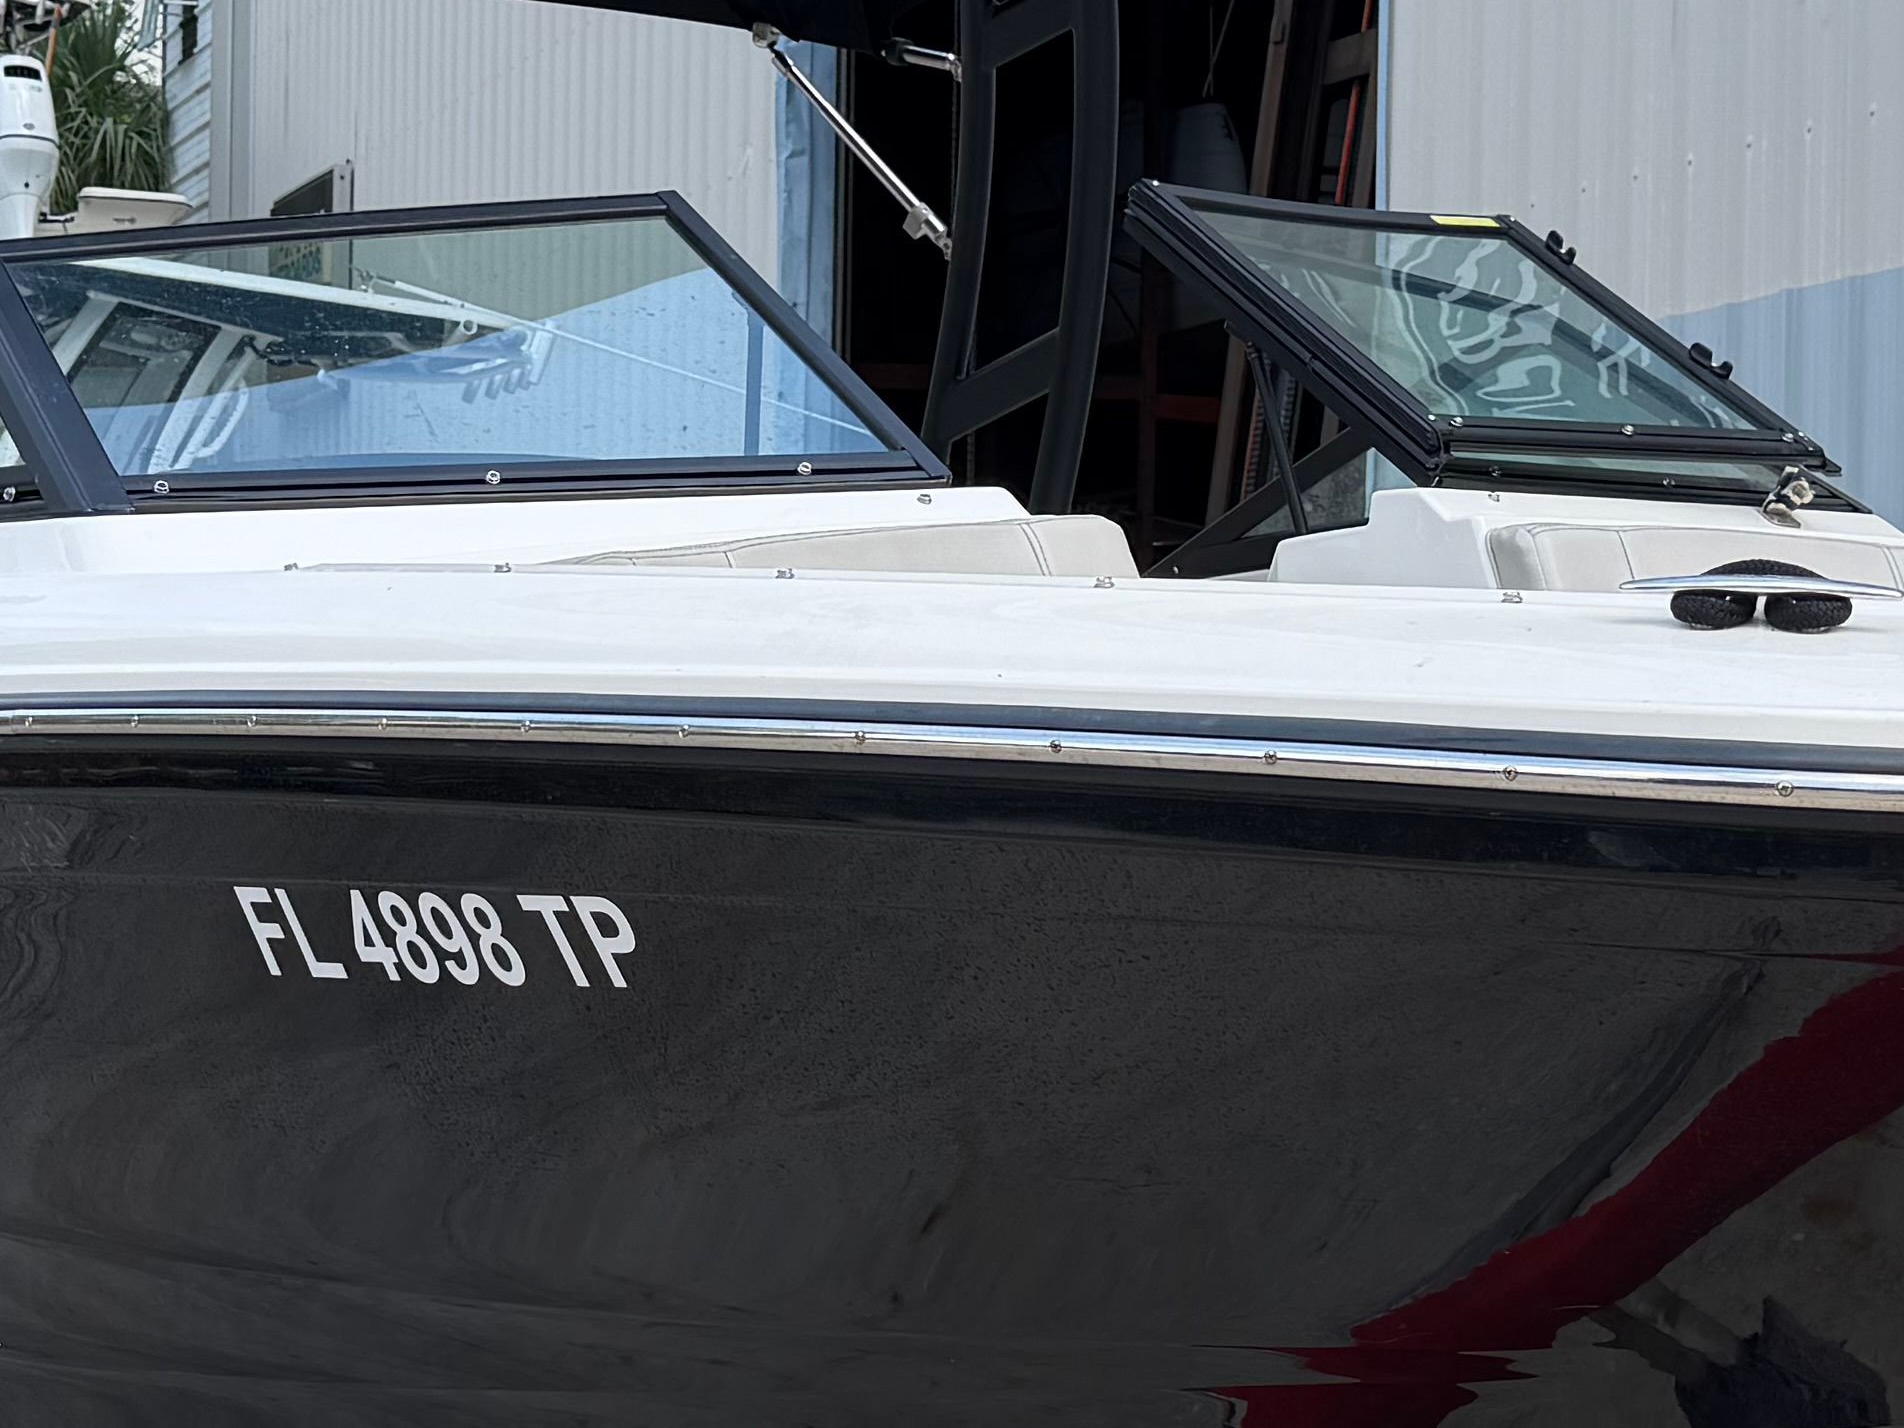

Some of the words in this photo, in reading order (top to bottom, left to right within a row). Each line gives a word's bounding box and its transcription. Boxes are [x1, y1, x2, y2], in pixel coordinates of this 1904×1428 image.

[232, 885, 349, 980] FL
[348, 888, 526, 988] 4898
[516, 893, 637, 989] TP
